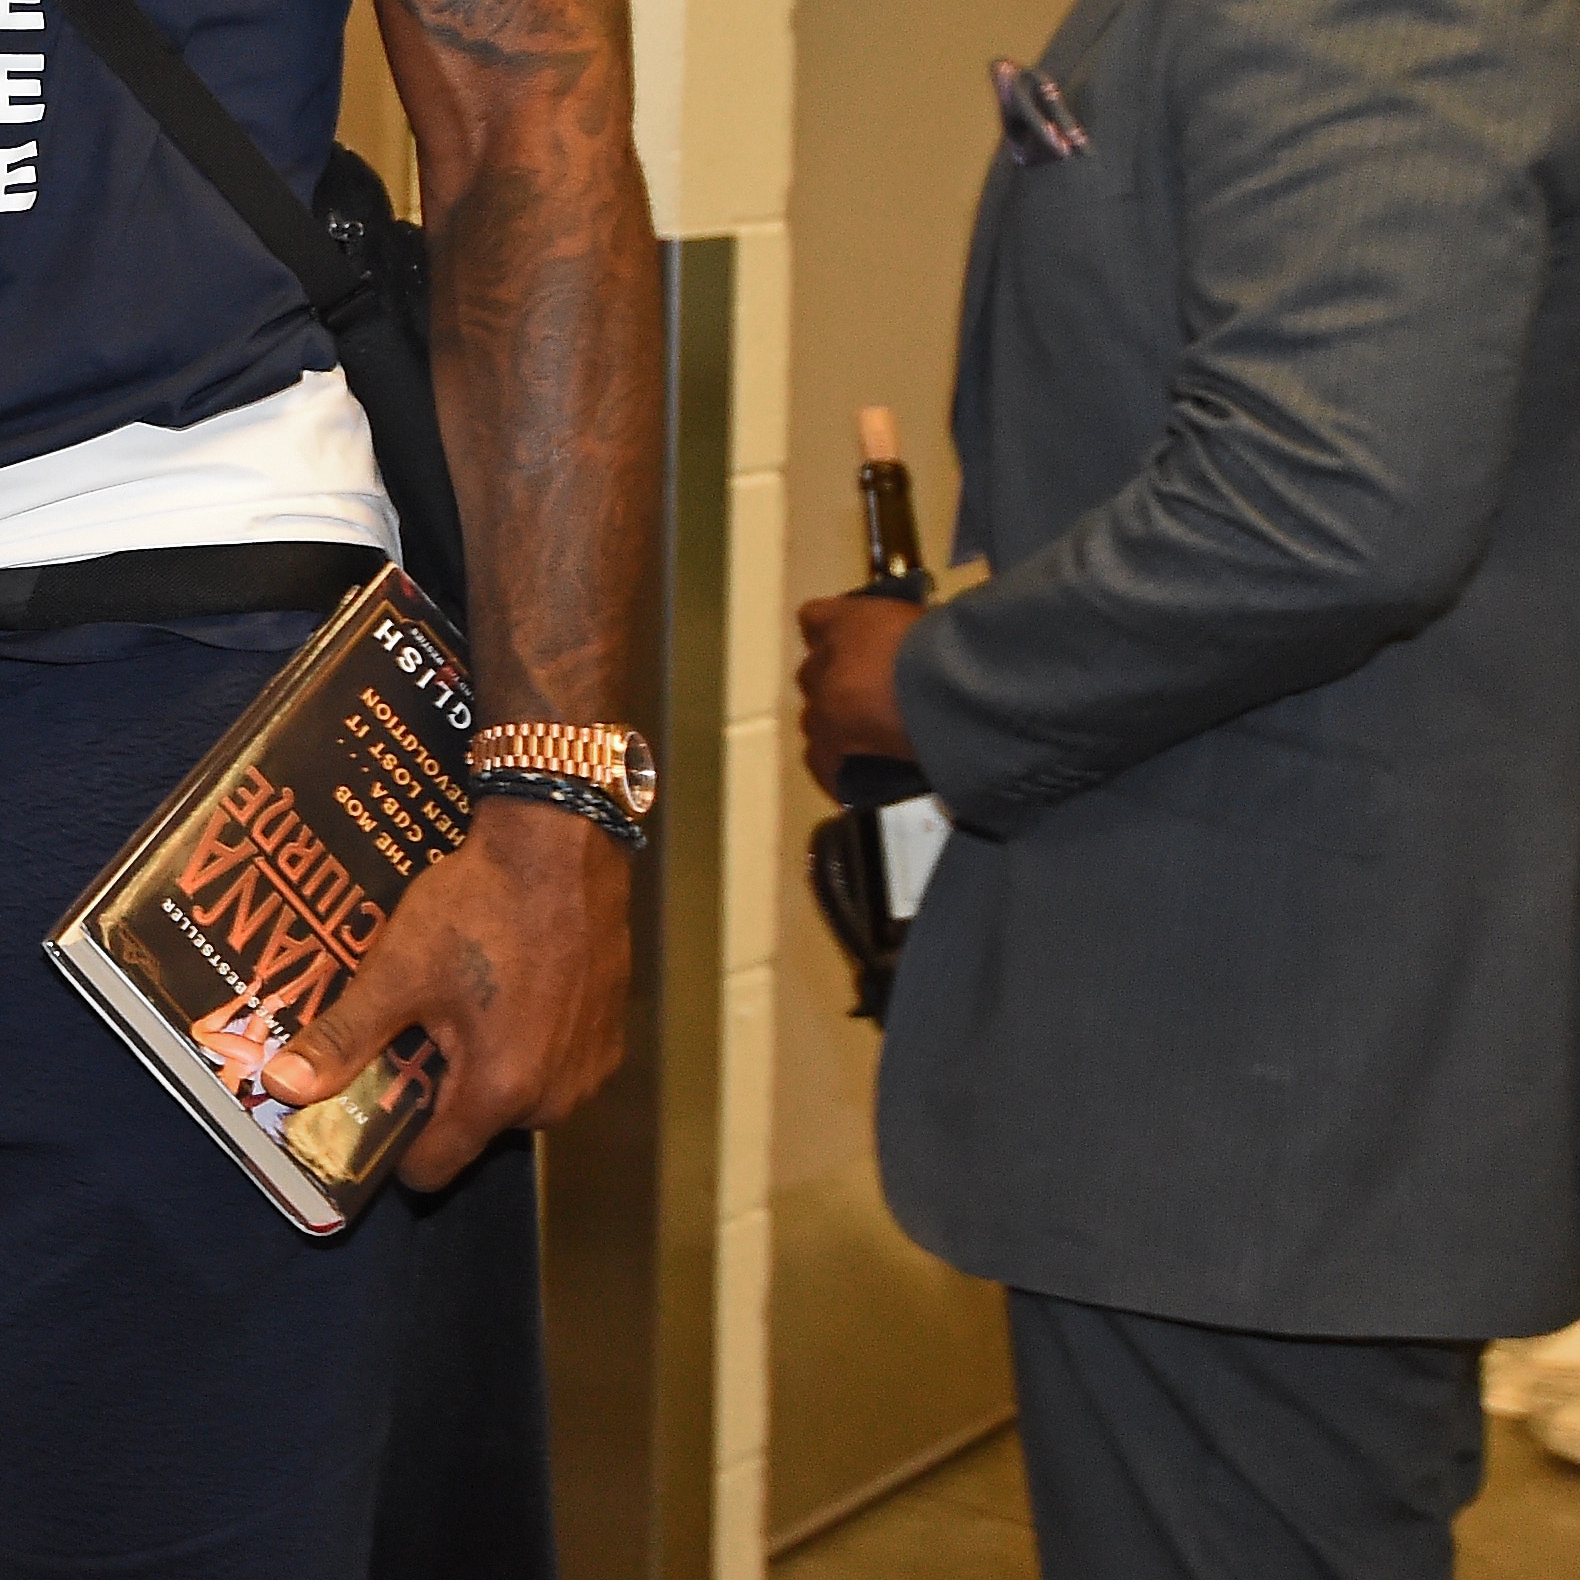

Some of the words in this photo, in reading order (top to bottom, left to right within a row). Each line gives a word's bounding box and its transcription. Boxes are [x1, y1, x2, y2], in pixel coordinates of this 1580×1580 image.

[373, 618, 473, 732] GLISH
[343, 713, 370, 739] IT
[361, 687, 471, 814] REVOLUTION
[368, 742, 423, 799] LOST
[331, 783, 378, 832] MOB
[366, 780, 425, 844] CUBA
[420, 799, 466, 847] HEN
[221, 764, 387, 969] CTURNE
[373, 830, 413, 877] THE
[160, 897, 248, 995] BESTSELLER
[245, 994, 293, 1044] TIMES
